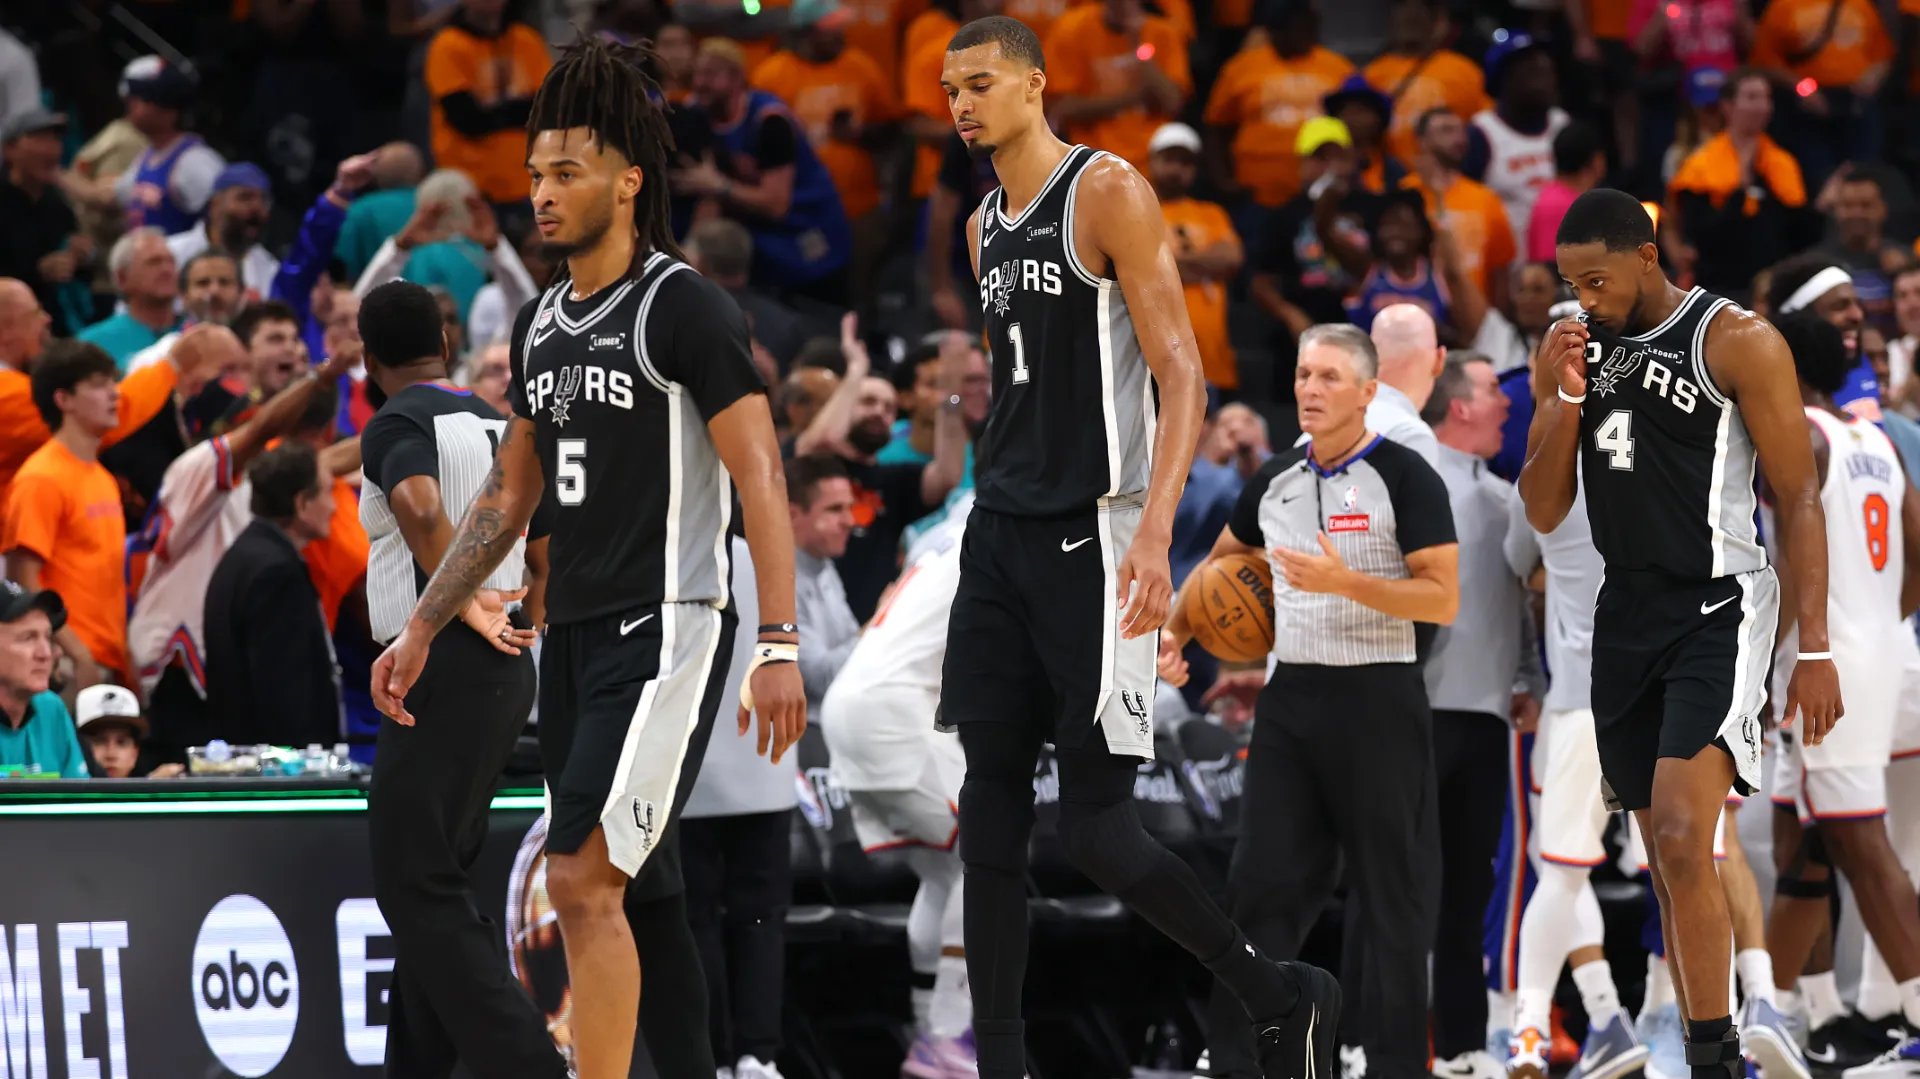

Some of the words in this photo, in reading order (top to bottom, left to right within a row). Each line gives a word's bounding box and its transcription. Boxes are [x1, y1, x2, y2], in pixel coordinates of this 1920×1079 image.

[1030, 226, 1054, 237] LEDGER
[593, 337, 620, 347] LEDGER
[1007, 322, 1030, 385] 1
[1648, 347, 1679, 360] LEDGER
[1594, 408, 1635, 472] 4
[556, 438, 587, 506] 5
[1328, 517, 1368, 530] Emirates
[1863, 492, 1889, 572] 8
[201, 949, 291, 1011] abc
